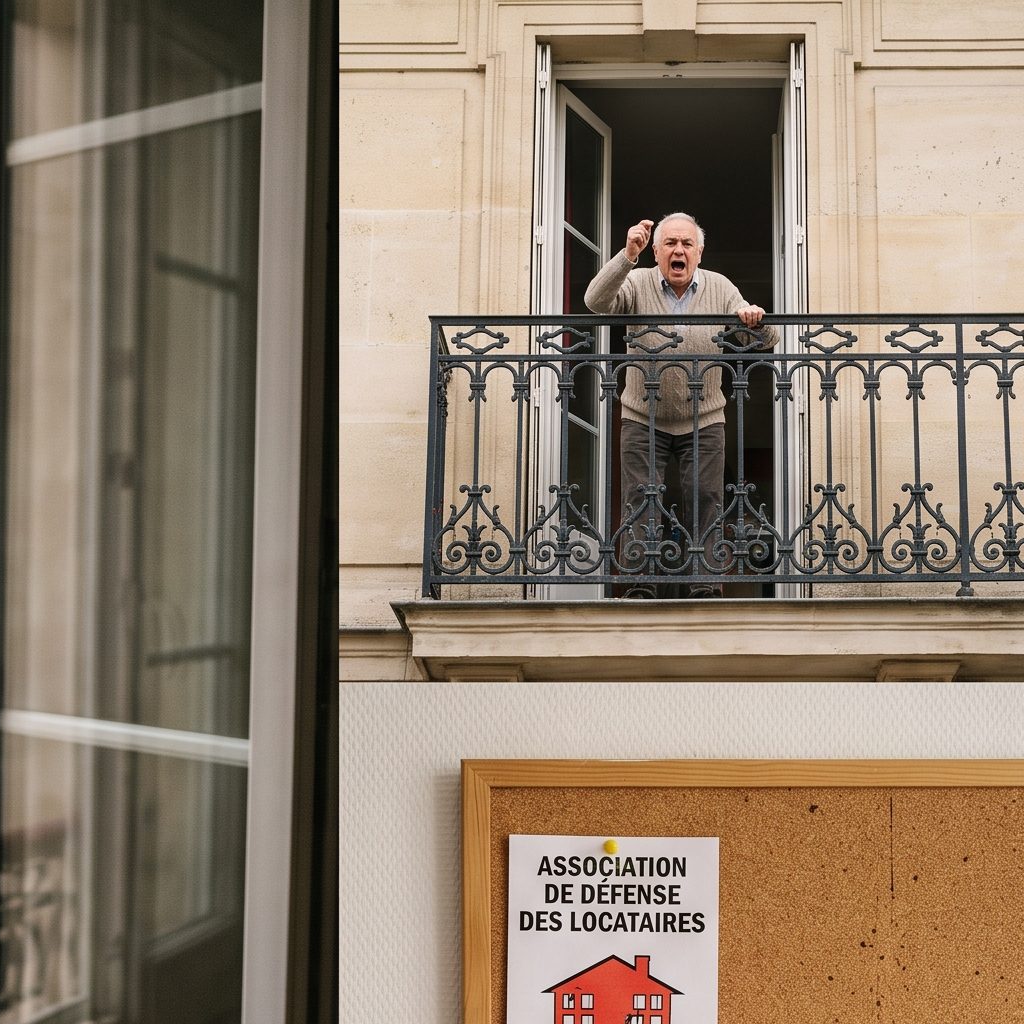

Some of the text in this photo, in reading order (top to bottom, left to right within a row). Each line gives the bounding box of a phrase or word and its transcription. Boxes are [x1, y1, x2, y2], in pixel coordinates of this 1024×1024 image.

[537, 856, 687, 878] ASSOCIATION
[544, 877, 681, 905] DE DÉFENSE
[519, 911, 705, 933] DES LOCATAIRES
